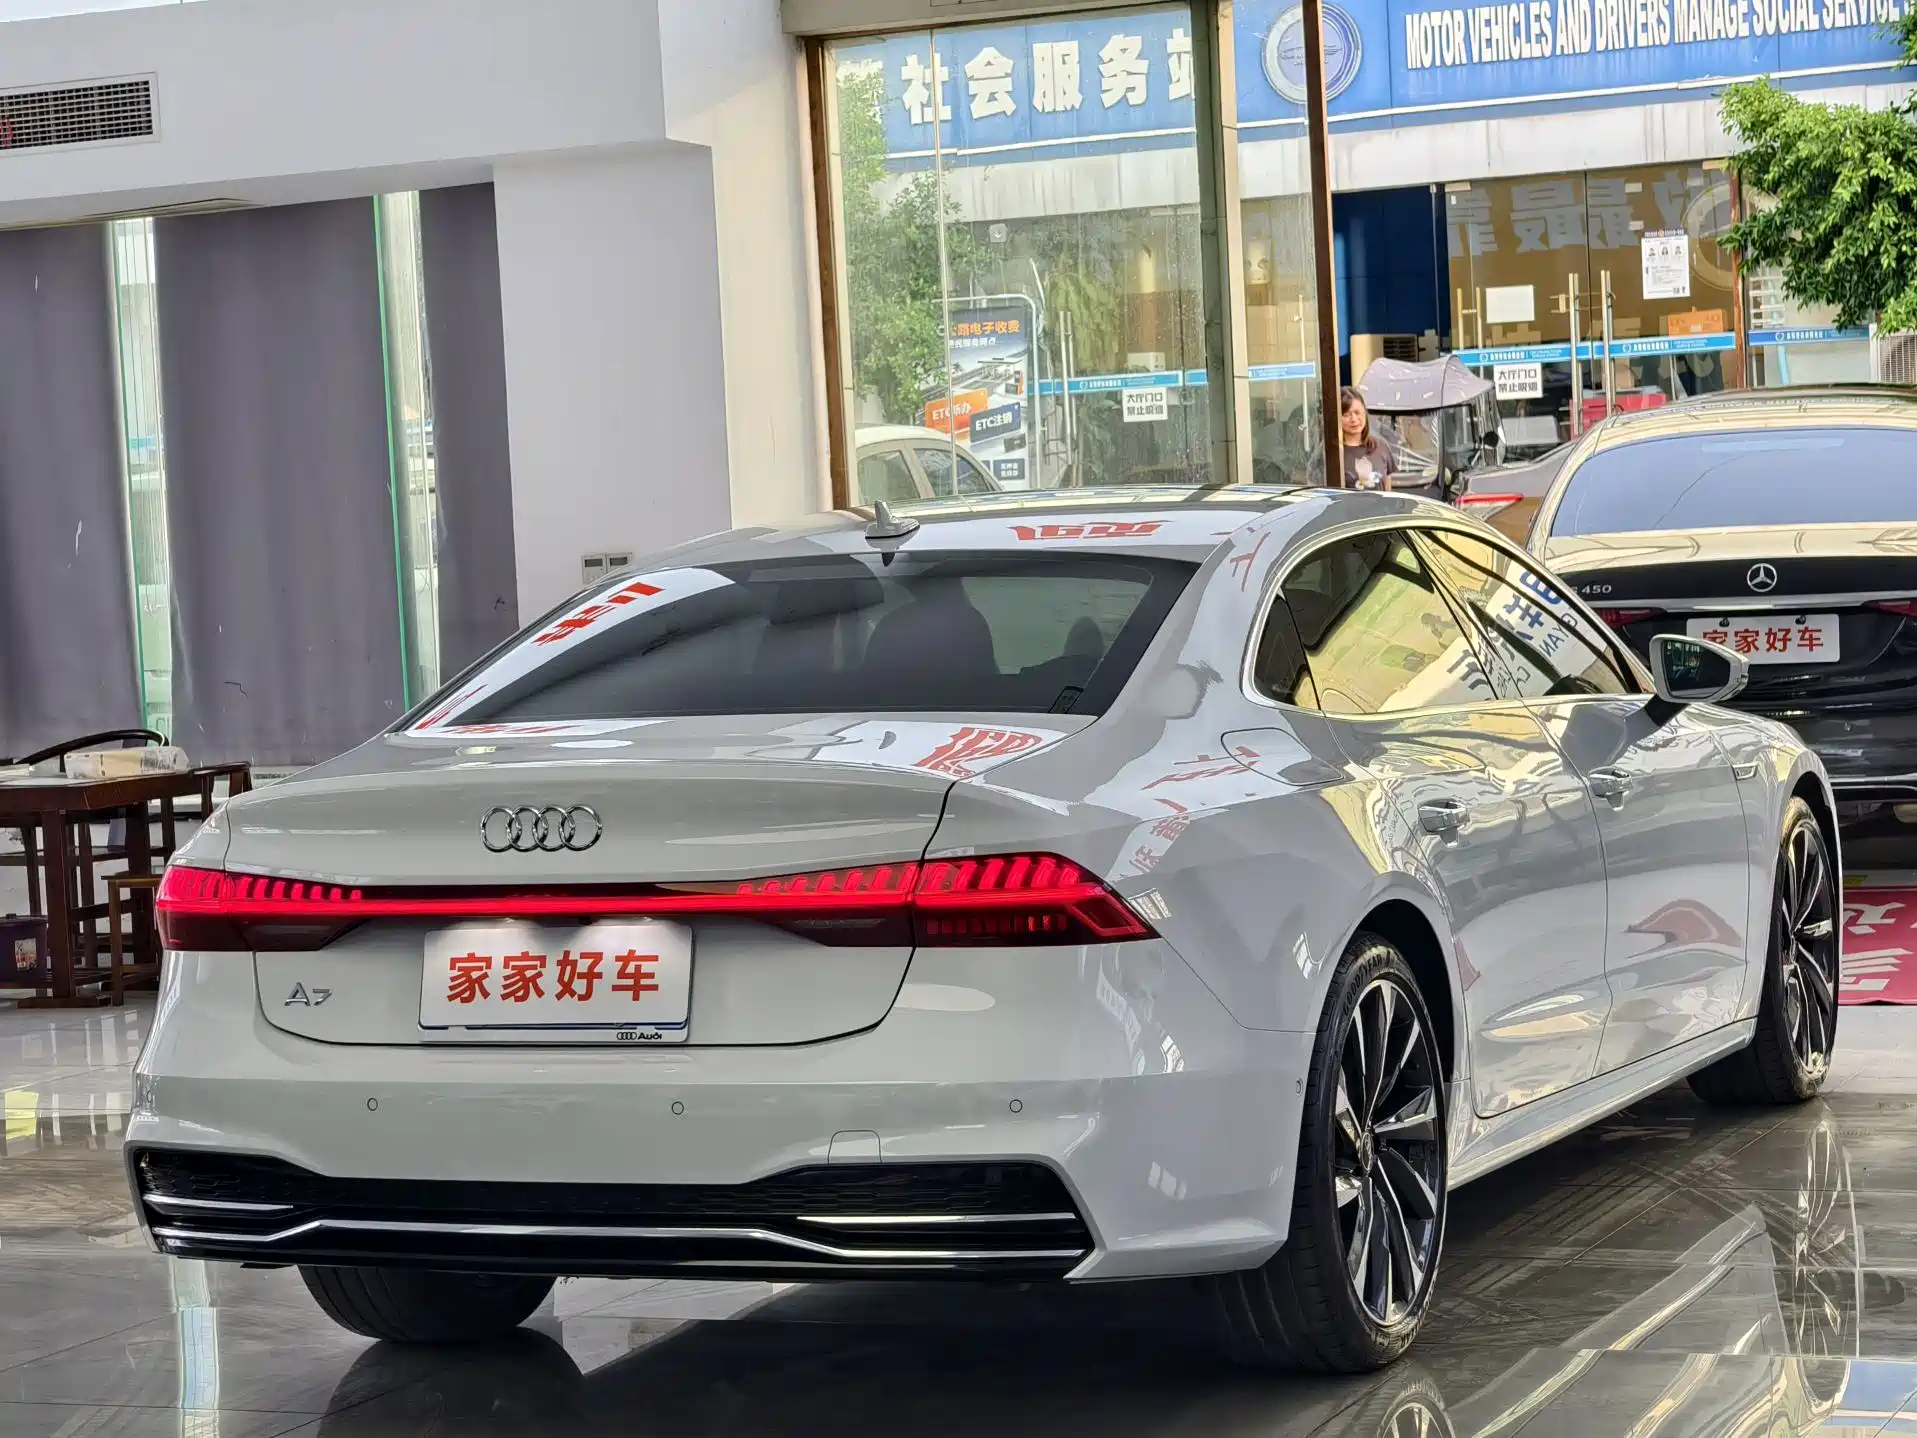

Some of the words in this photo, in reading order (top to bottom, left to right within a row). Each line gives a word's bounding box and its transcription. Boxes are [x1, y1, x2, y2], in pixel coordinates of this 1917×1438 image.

[1406, 10, 1467, 69] MOTOR
[1468, 1, 1551, 63] VEHICLES
[1556, 0, 1592, 55] AND
[1595, 0, 1669, 52] DRIVERS
[1673, 0, 1749, 44] MANAGE
[1498, 368, 1537, 380] 大厅门口
[1498, 381, 1537, 393] 禁止吸烟
[1126, 392, 1163, 403] 大厅门口
[1581, 584, 1612, 594] 450
[447, 949, 660, 1004] 家家好车
[284, 982, 332, 1007] A7
[638, 1032, 662, 1040] Audi
